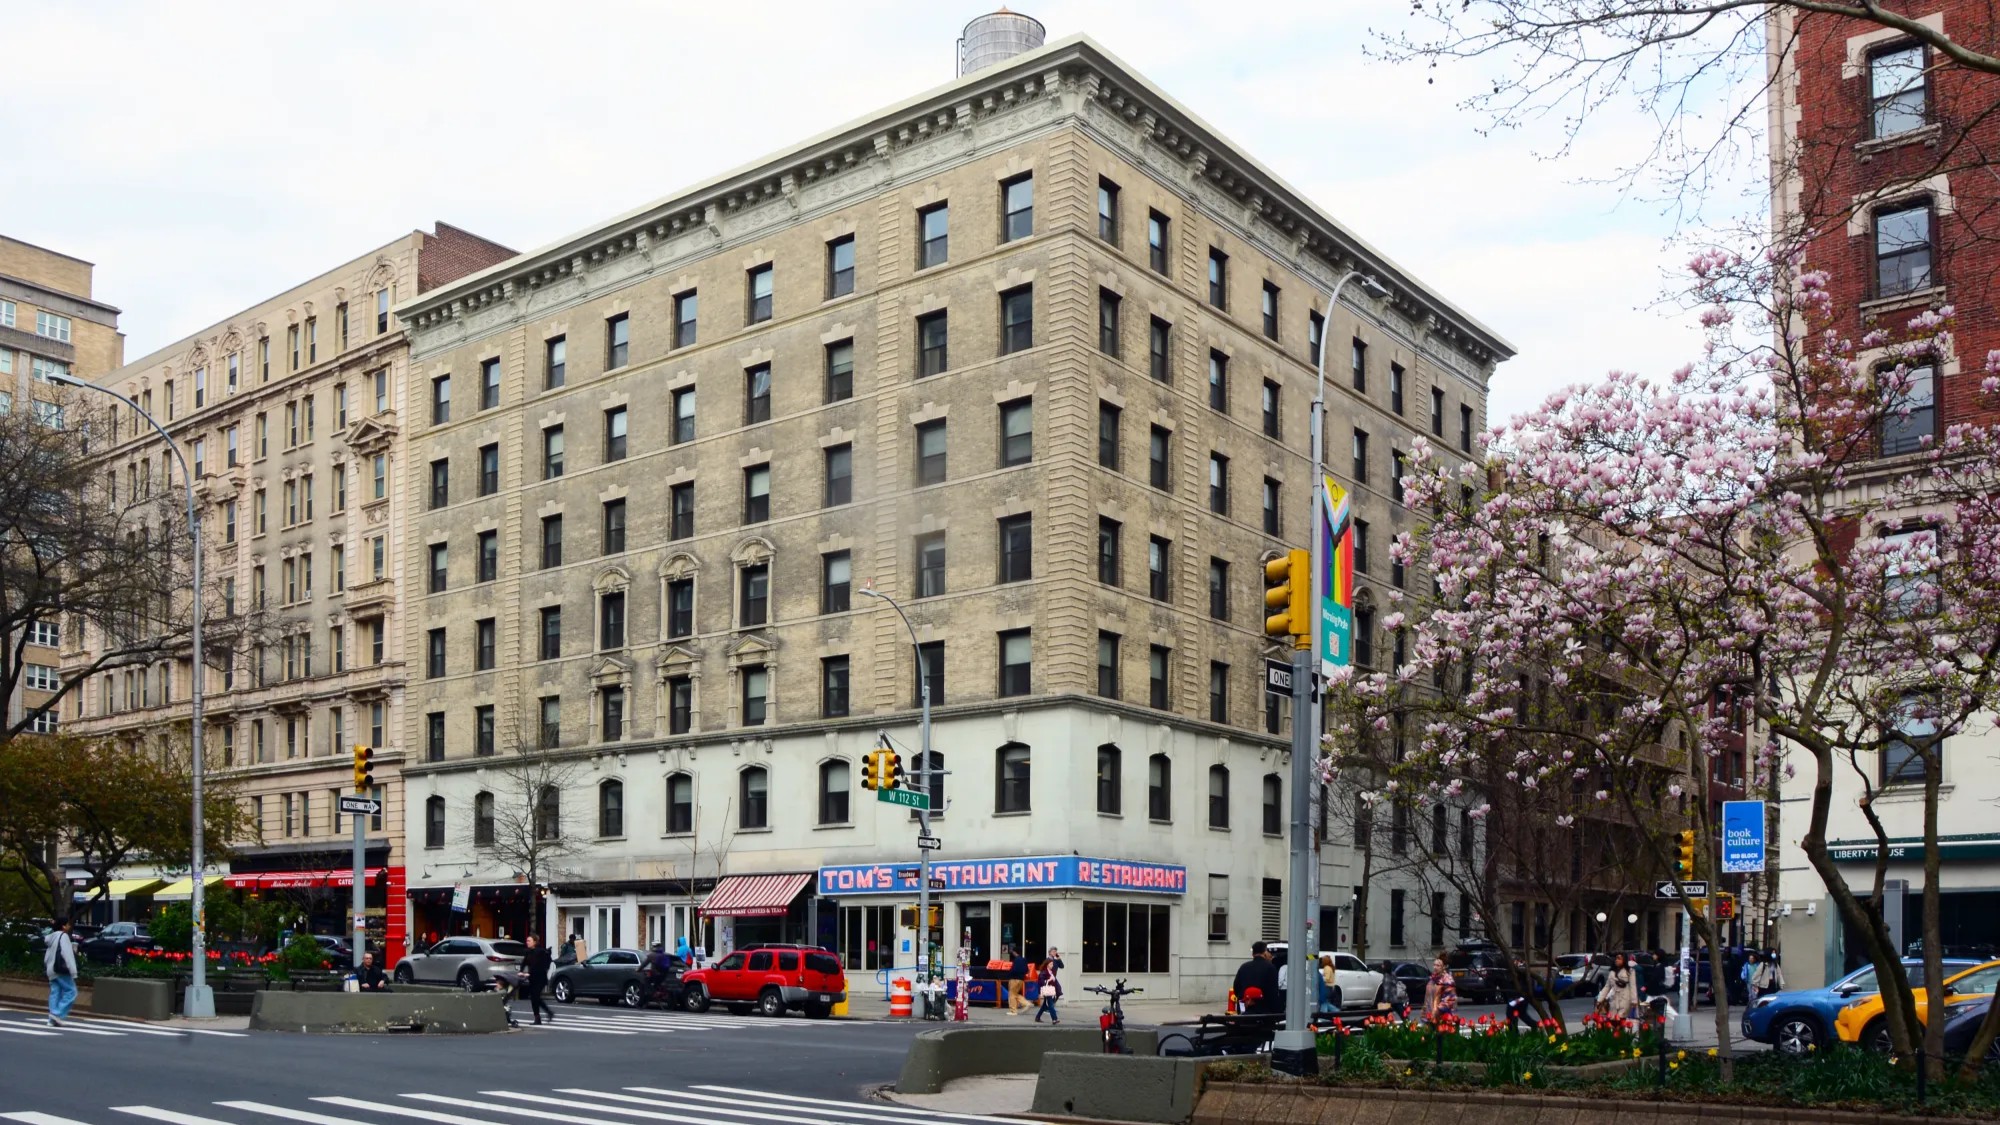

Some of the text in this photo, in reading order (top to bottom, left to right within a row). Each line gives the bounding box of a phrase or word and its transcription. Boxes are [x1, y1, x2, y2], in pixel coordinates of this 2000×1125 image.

[1273, 671, 1290, 687] ONE
[889, 790, 919, 806] W 112 St
[346, 801, 358, 809] ONE
[1727, 828, 1752, 838] book
[1727, 837, 1761, 846] culture
[1834, 848, 1905, 859] LIBERTY HUSE
[823, 865, 893, 889] TOM'S
[1078, 861, 1185, 889] RESTAURANT
